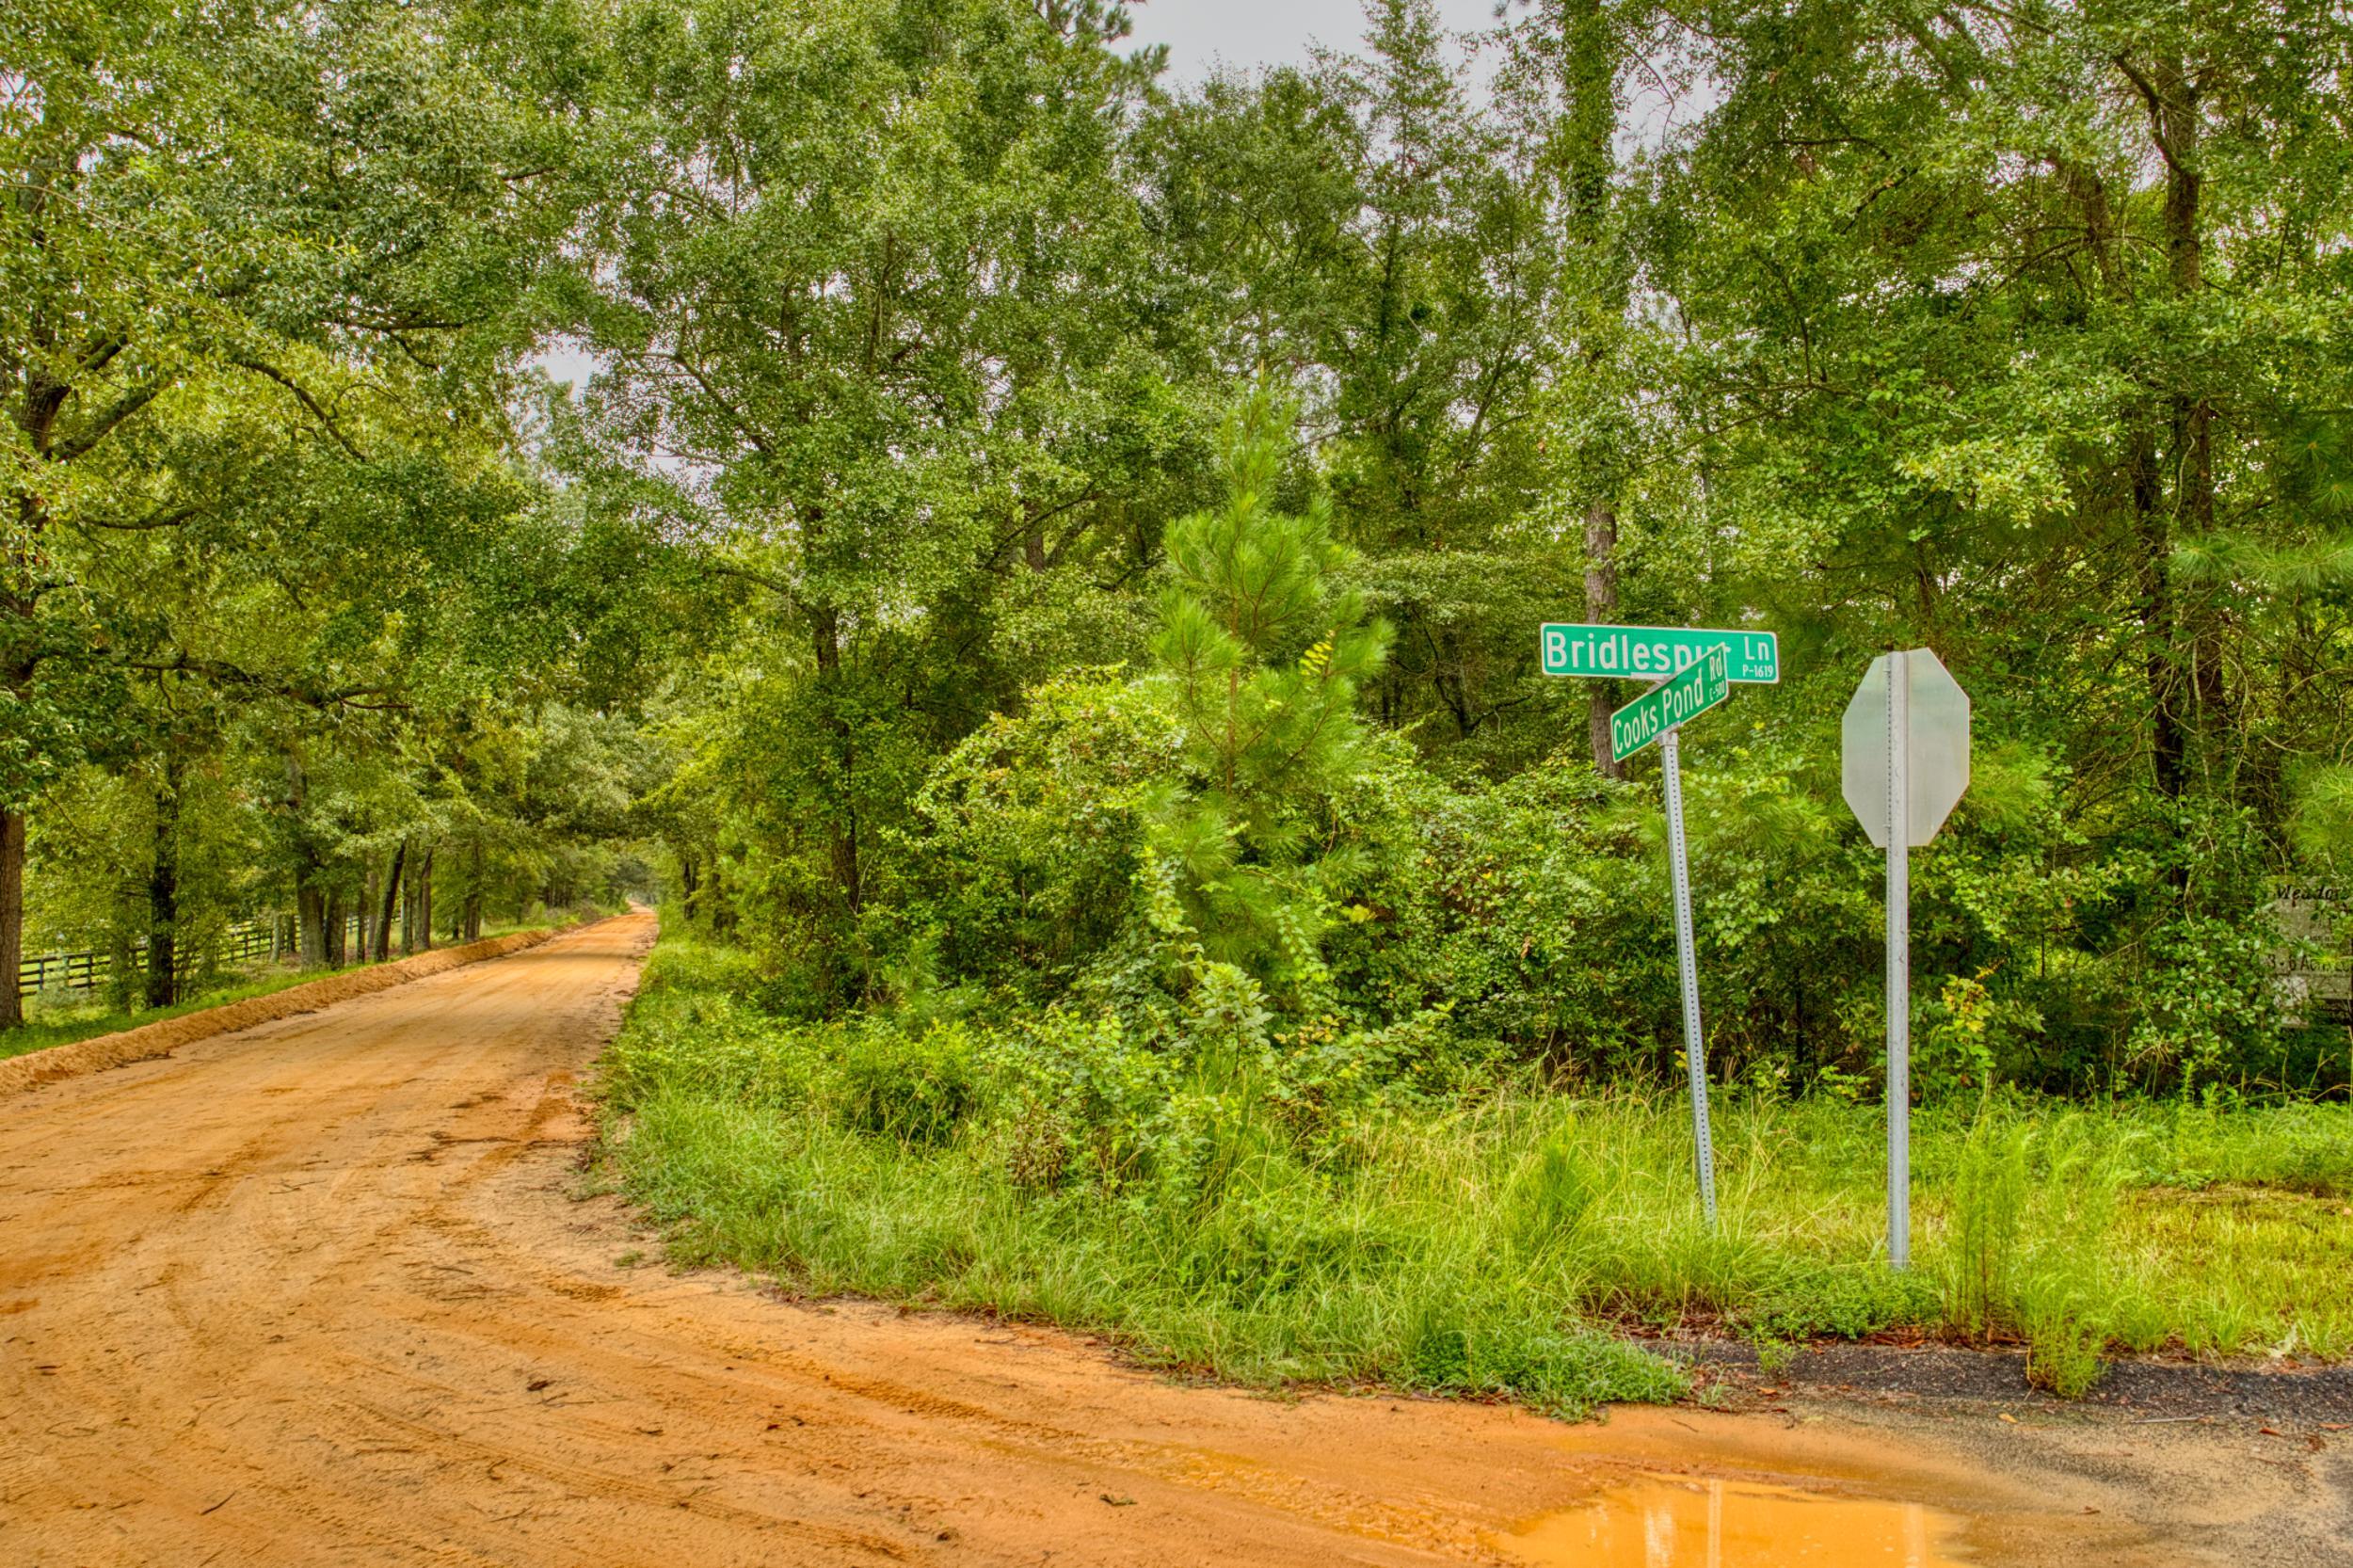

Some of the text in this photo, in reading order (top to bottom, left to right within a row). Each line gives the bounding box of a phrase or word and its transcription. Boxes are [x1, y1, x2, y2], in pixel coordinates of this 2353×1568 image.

[1546, 631, 1769, 674] Bridlesp Ln
[1742, 664, 1773, 678] P-1619
[1613, 650, 1722, 754] Cooks Pond Rd
